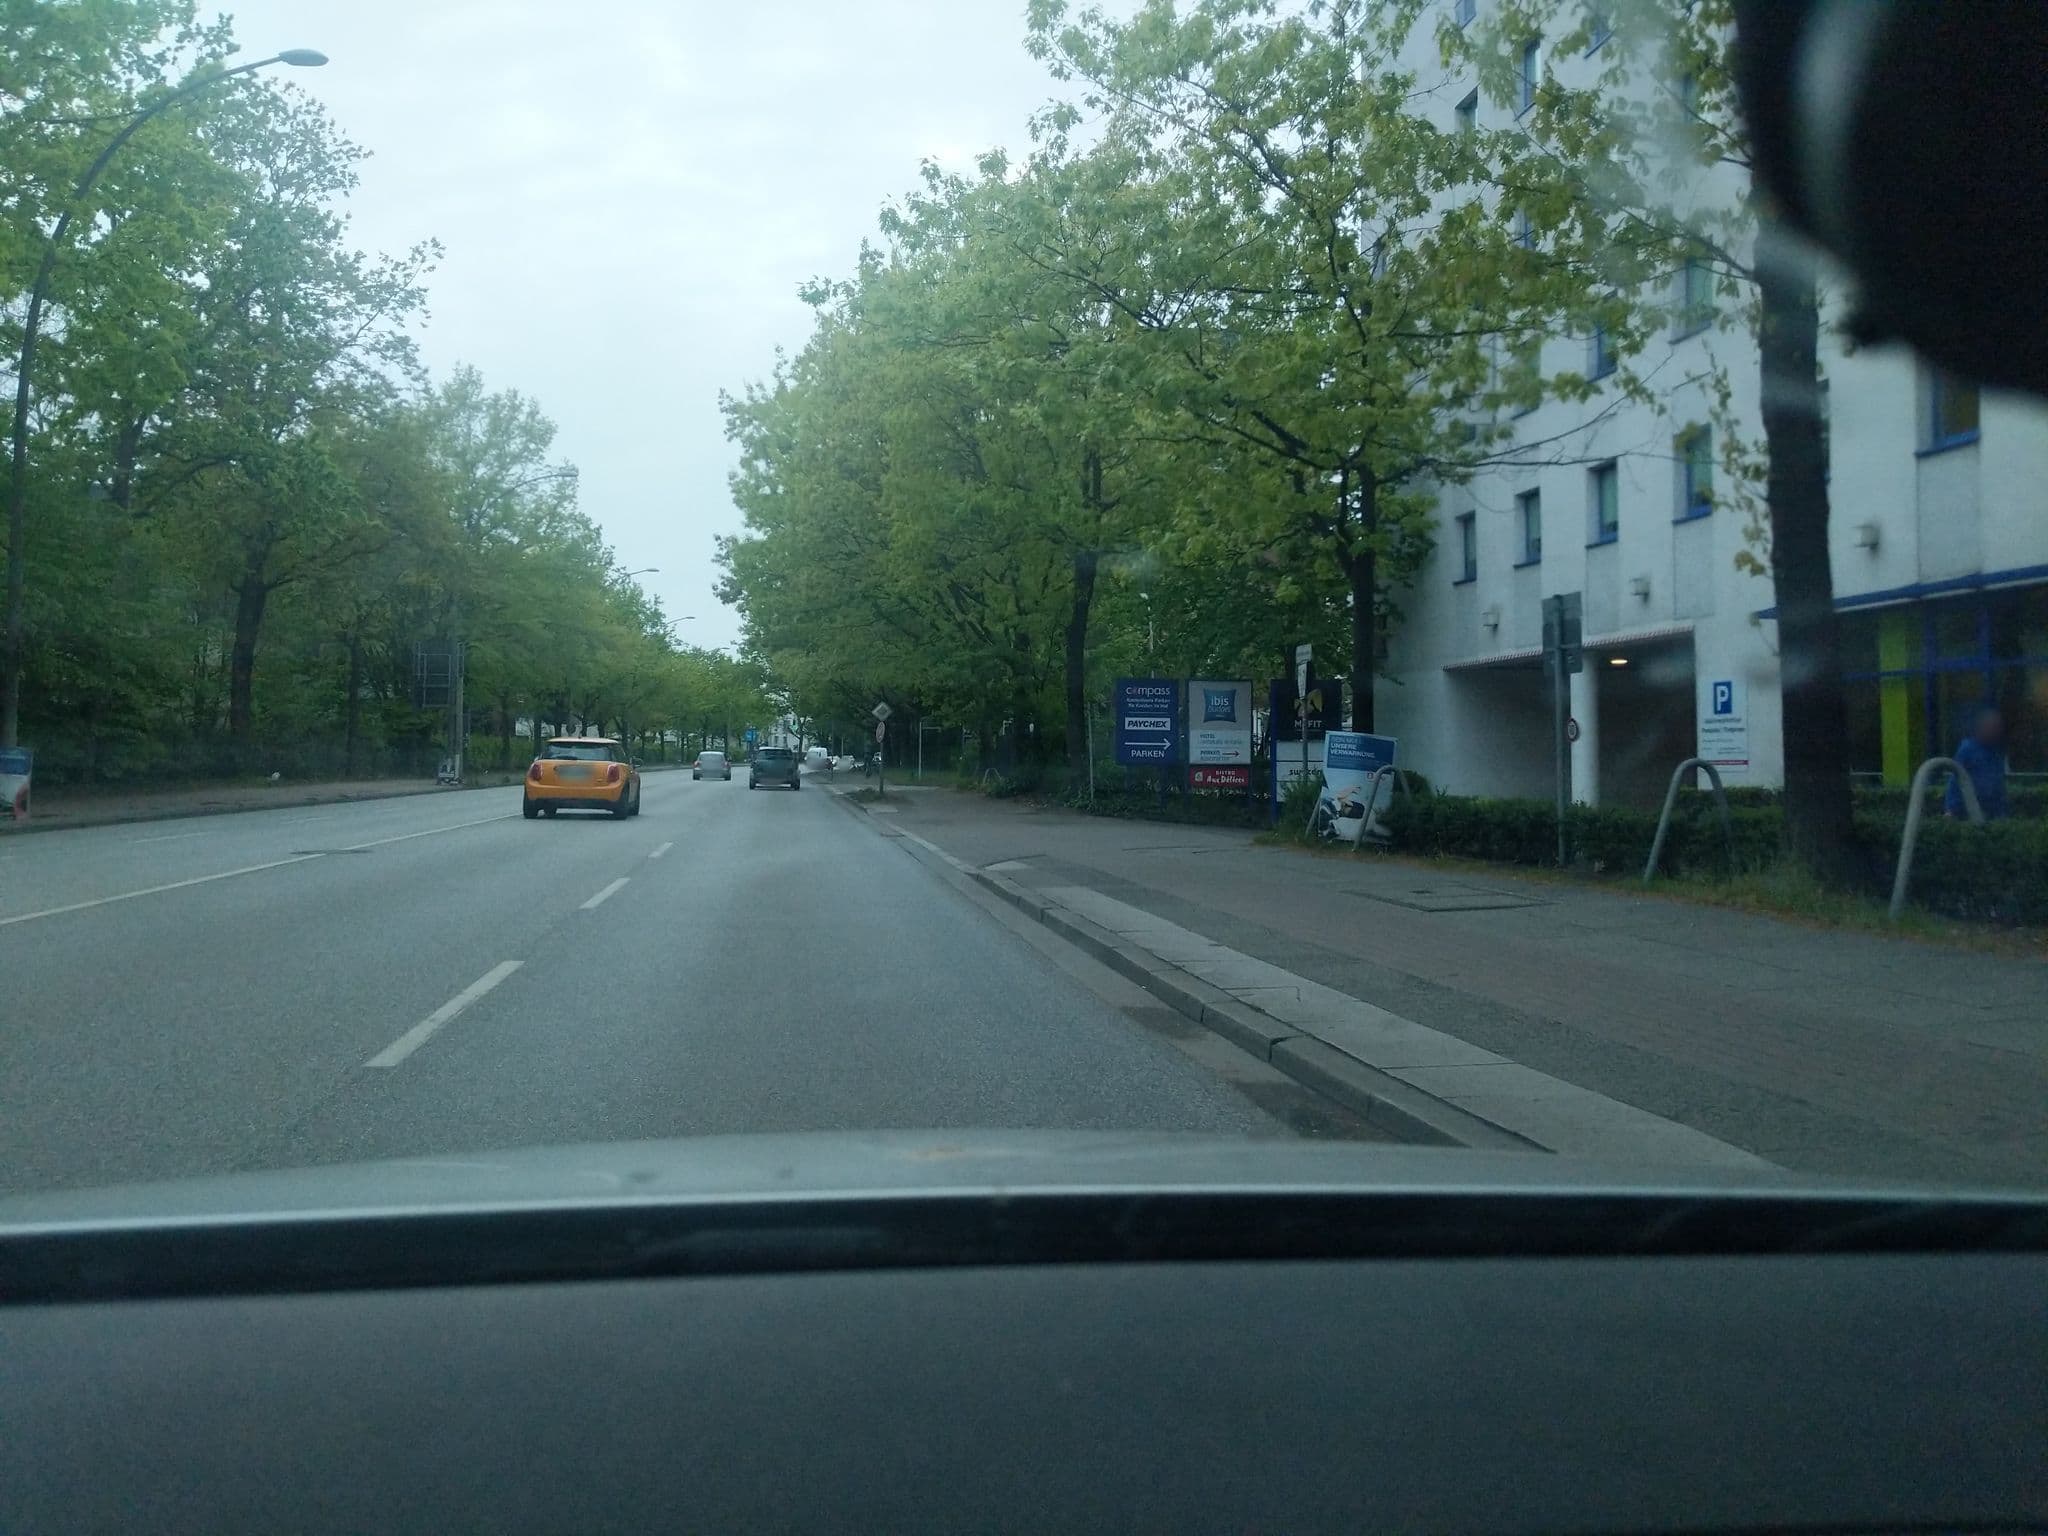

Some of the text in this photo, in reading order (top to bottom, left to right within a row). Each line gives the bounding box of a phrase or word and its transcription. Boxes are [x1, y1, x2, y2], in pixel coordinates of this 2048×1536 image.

[1211, 695, 1229, 706] ibis
[1716, 685, 1729, 711] P
[1127, 720, 1167, 728] PAYCHEX
[1131, 750, 1165, 758] PARKEN
